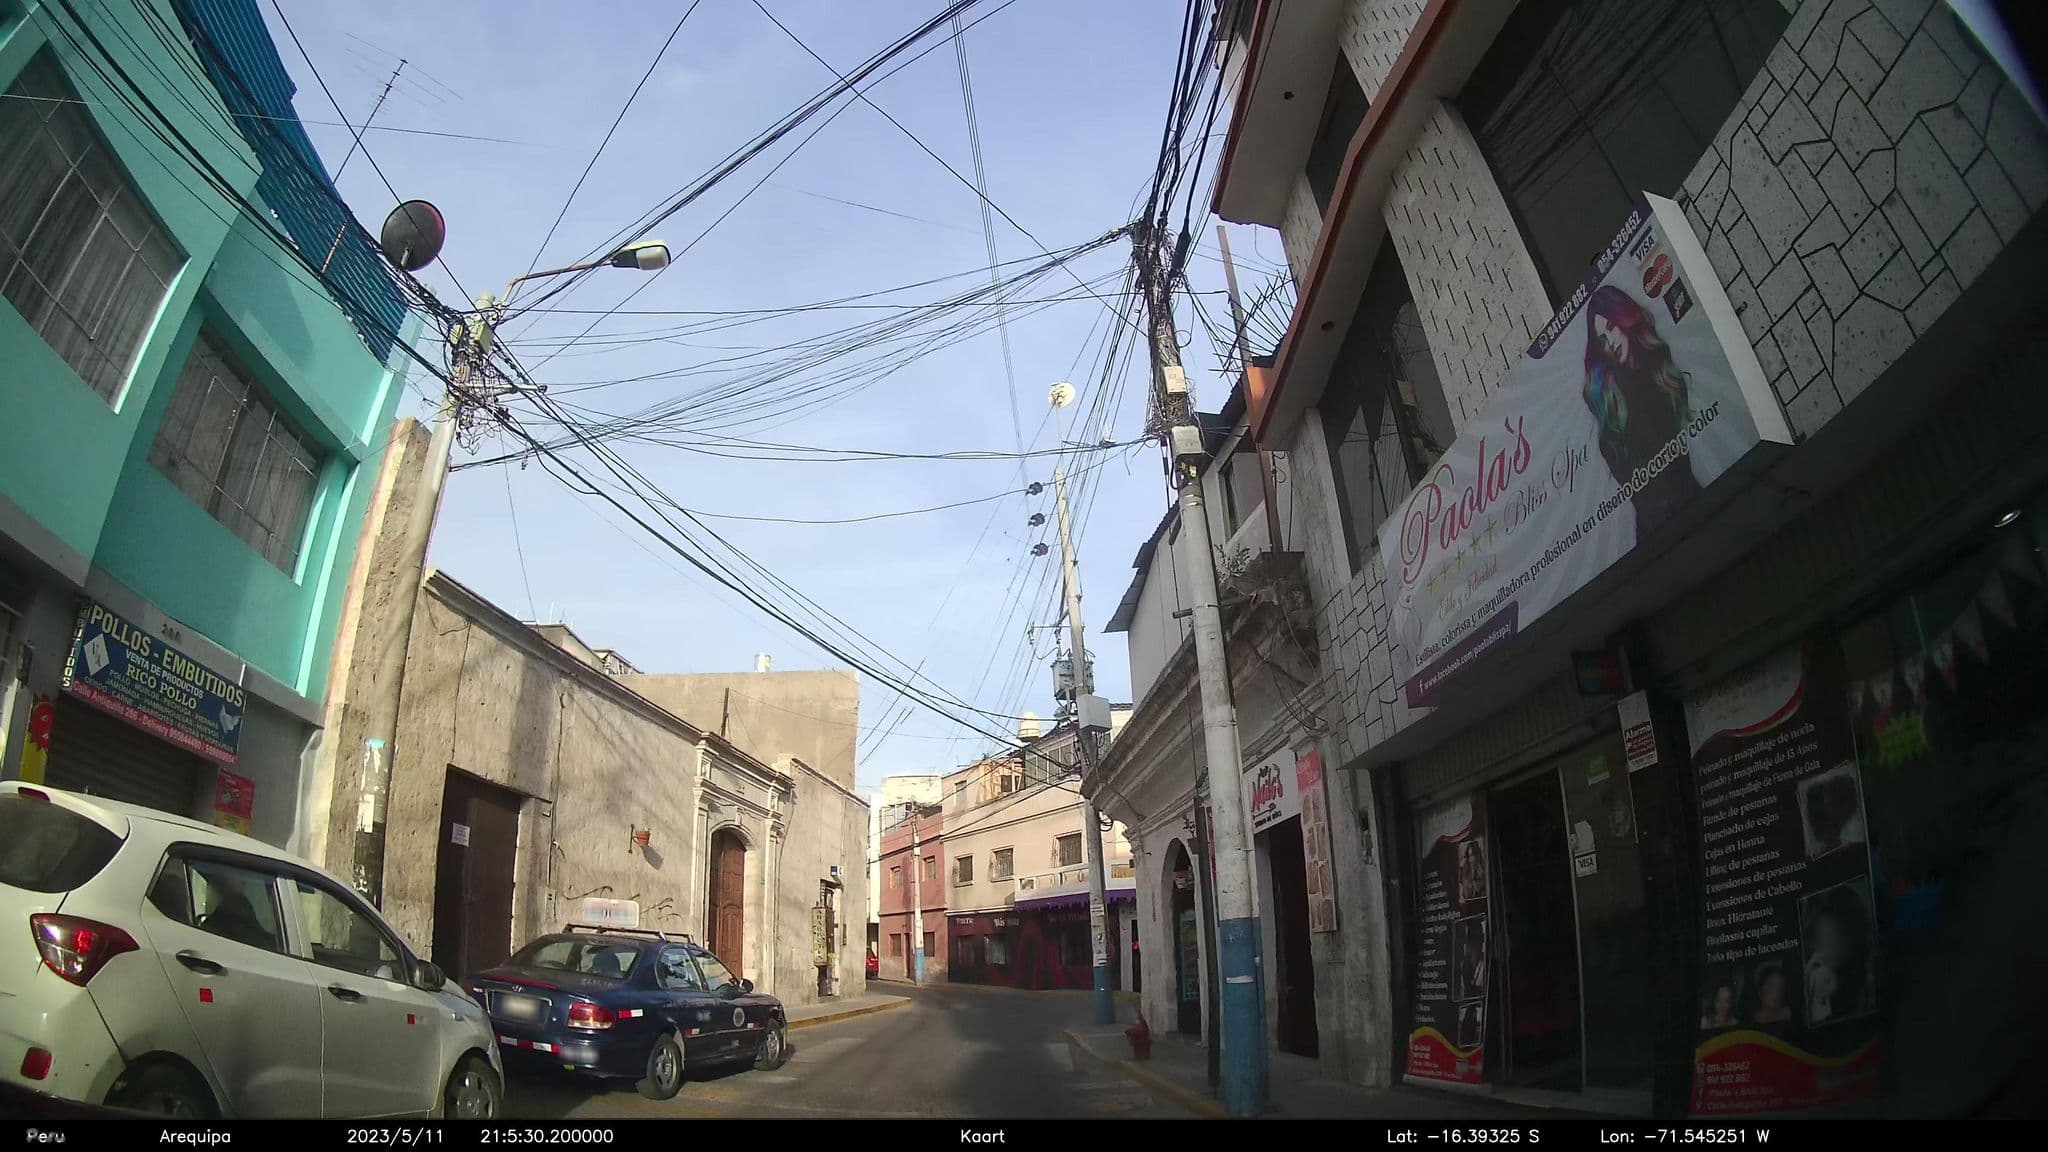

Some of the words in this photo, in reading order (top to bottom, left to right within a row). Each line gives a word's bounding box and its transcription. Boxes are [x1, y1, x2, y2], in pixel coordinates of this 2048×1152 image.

[1635, 235, 1655, 262] VISA
[1548, 321, 1560, 340] 941
[1559, 305, 1574, 324] 922
[1551, 440, 1590, 493] Spa
[1441, 618, 1471, 647] colorista
[1471, 614, 1476, 628] y
[1477, 574, 1530, 621] maquilladora
[1531, 525, 1582, 580] profesional
[1582, 515, 1596, 534] en
[1597, 486, 1632, 521] diseño
[1633, 468, 1648, 490] de
[1649, 441, 1680, 477] corte
[1679, 431, 1688, 454] y
[1688, 400, 1720, 438] color
[90, 604, 152, 657] POLLOS
[162, 649, 244, 708] EMBUTIDOS
[126, 649, 150, 671] VENTA
[151, 664, 162, 676] DE
[162, 670, 205, 700] PRODUCTOS
[126, 664, 157, 689] RICO
[160, 683, 197, 710] POLLO
[1777, 732, 1789, 745] de
[1774, 751, 1785, 765] de
[1787, 748, 1795, 761] 15
[1727, 806, 1738, 817] de
[1745, 818, 1755, 829] de
[1578, 857, 1595, 869] VISA
[1728, 859, 1741, 871] de
[1753, 871, 1766, 882] de
[1754, 888, 1766, 900] de
[1767, 880, 1803, 897] Cabello
[1744, 945, 1757, 957] de
